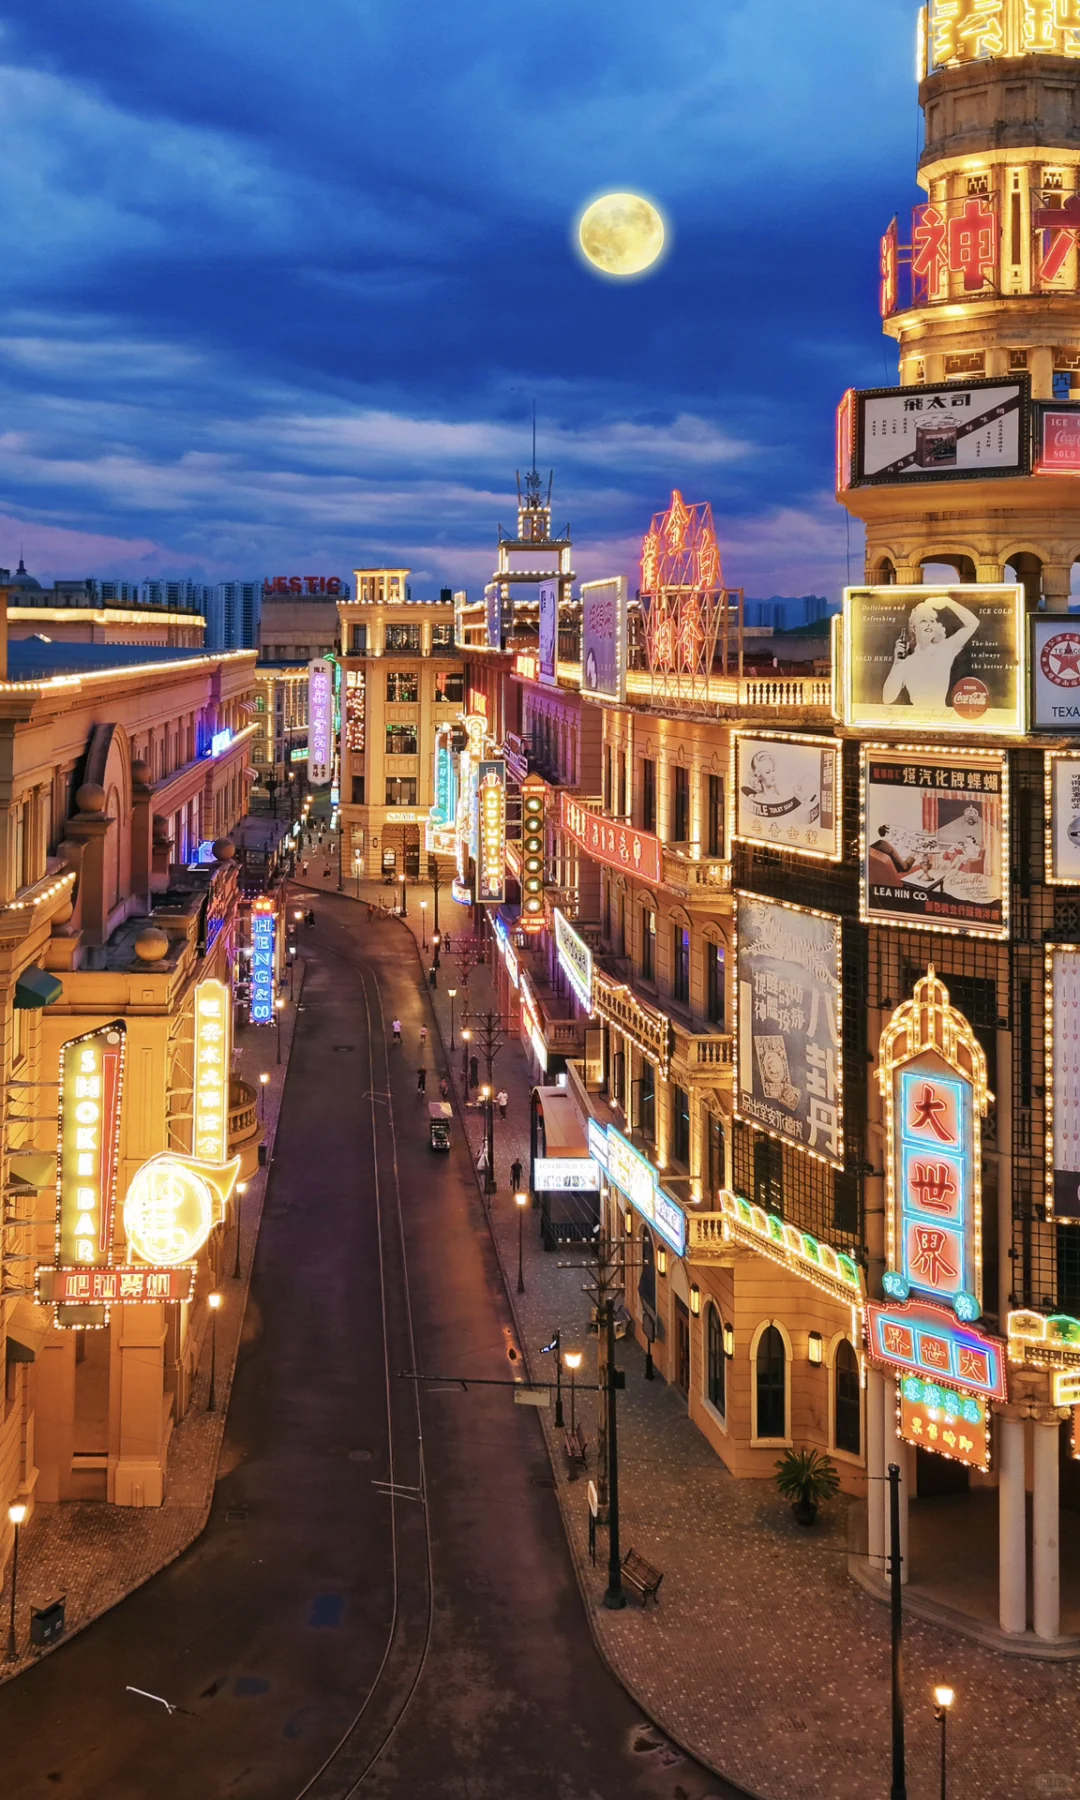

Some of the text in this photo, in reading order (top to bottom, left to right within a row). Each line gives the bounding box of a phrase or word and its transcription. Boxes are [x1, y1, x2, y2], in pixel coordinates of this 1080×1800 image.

[1051, 418, 1068, 426] ICE
[1053, 450, 1076, 458] SOLD
[874, 886, 930, 901] LEA HIN CO.
[74, 1049, 102, 1264] SMOKE BAR
[909, 1083, 957, 1288] 大世界
